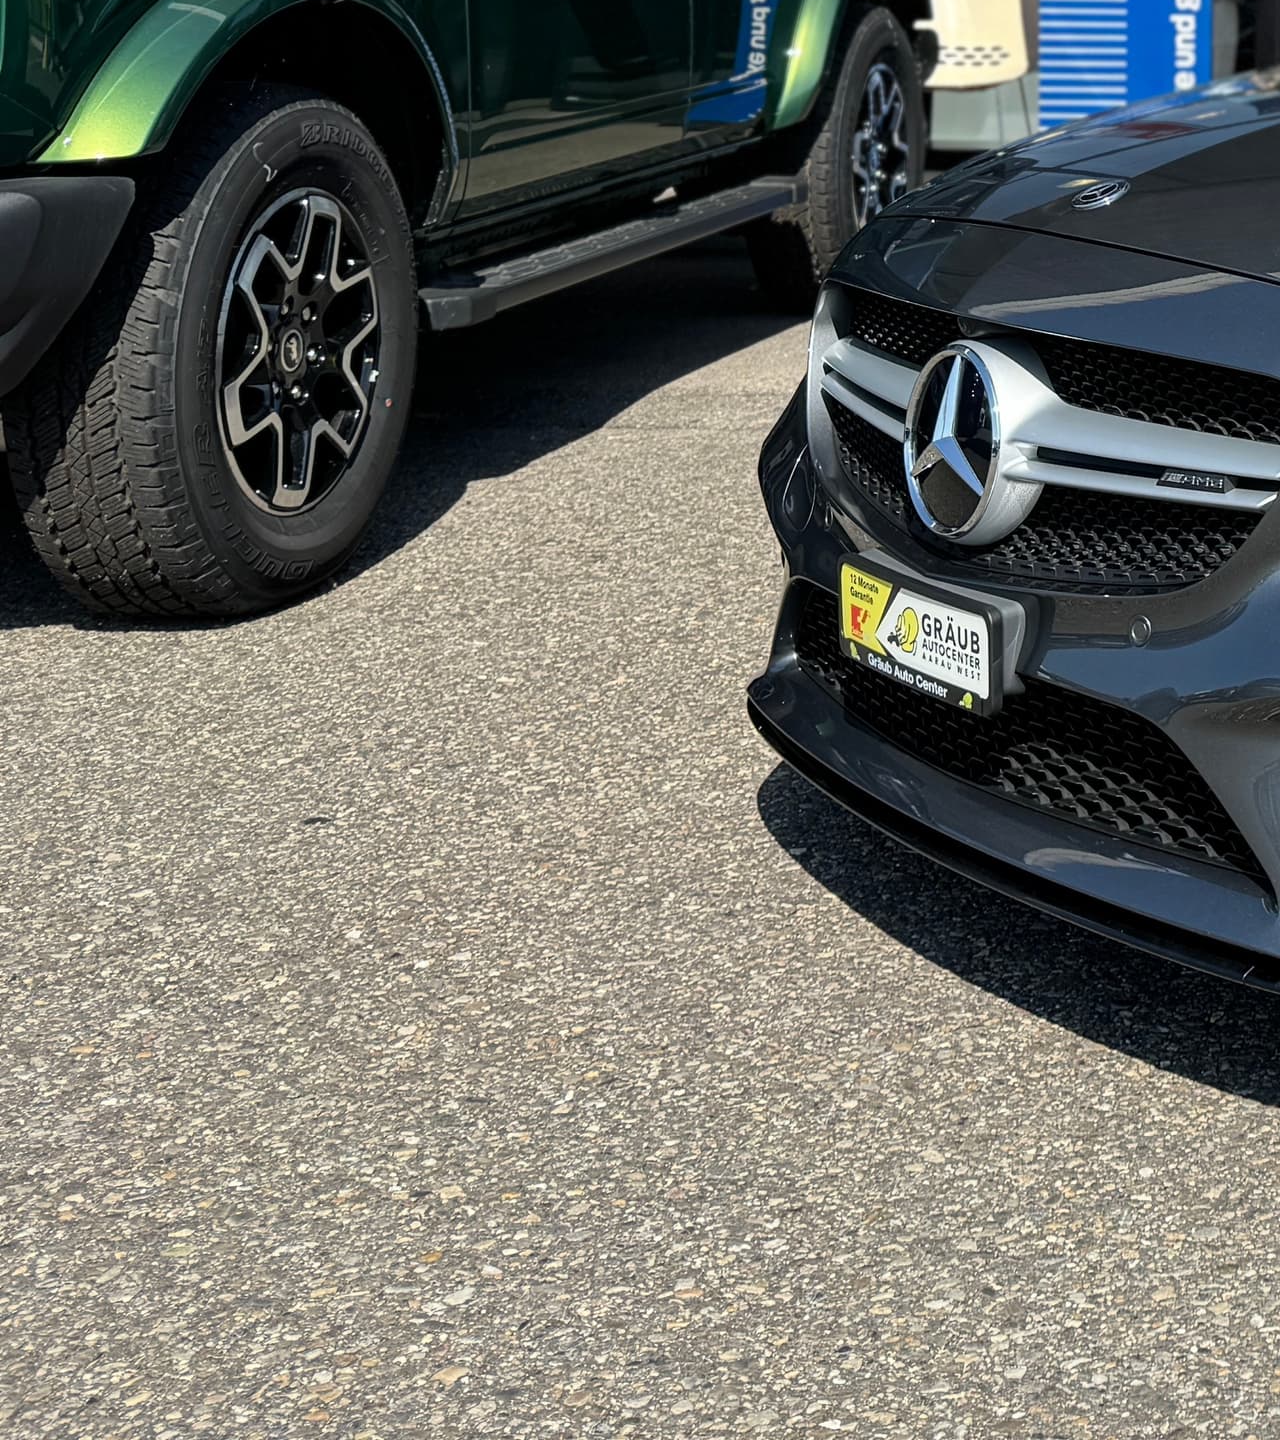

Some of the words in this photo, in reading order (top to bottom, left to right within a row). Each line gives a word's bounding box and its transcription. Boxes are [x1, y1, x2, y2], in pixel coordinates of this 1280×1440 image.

[1169, 14, 1196, 68] und
[850, 587, 874, 605] Garantie
[858, 575, 879, 594] Monate
[921, 613, 980, 654] GRÄUB
[922, 638, 980, 670] AUTOCENTER
[868, 653, 892, 675] Gräub
[893, 667, 914, 685] Auto
[915, 675, 948, 698] Center
